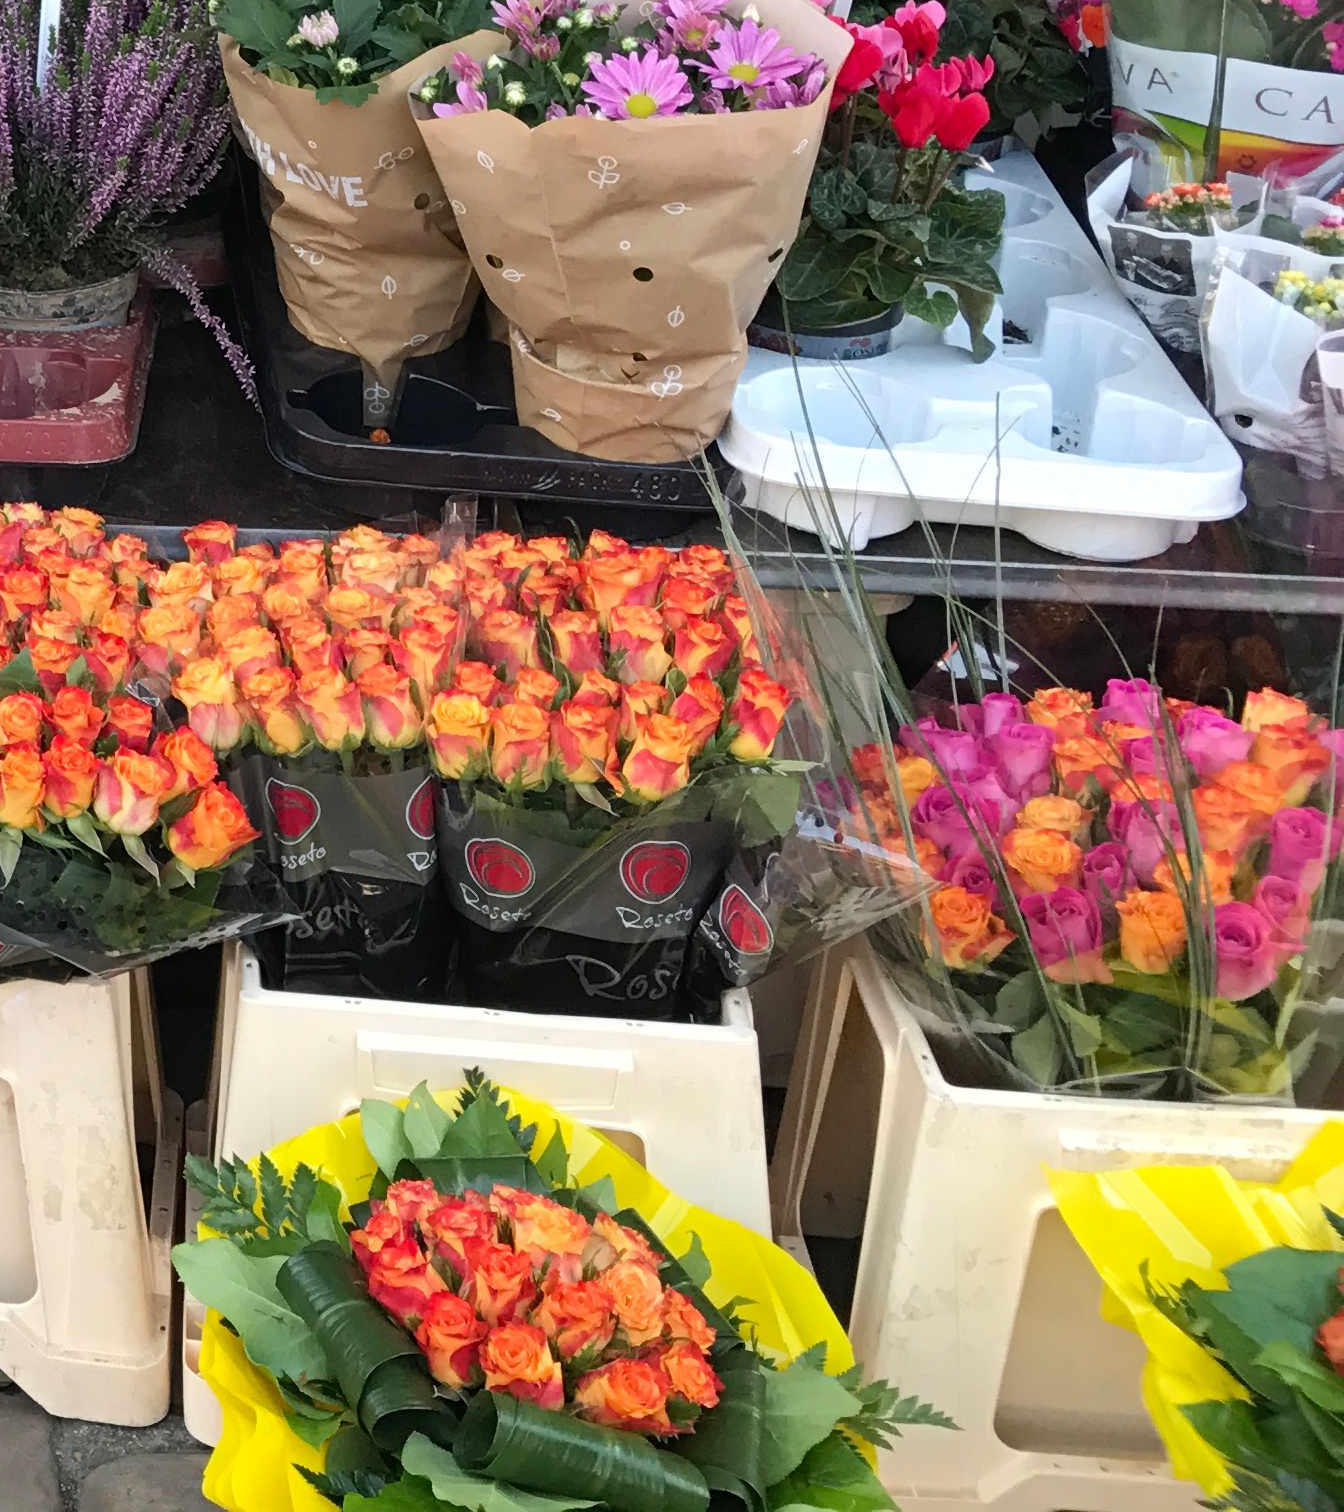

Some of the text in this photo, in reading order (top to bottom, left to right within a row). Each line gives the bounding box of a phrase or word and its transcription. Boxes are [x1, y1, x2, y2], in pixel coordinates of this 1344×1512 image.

[278, 151, 369, 208] LOVE
[615, 902, 694, 929] Roseto
[565, 954, 680, 1002] Ros
